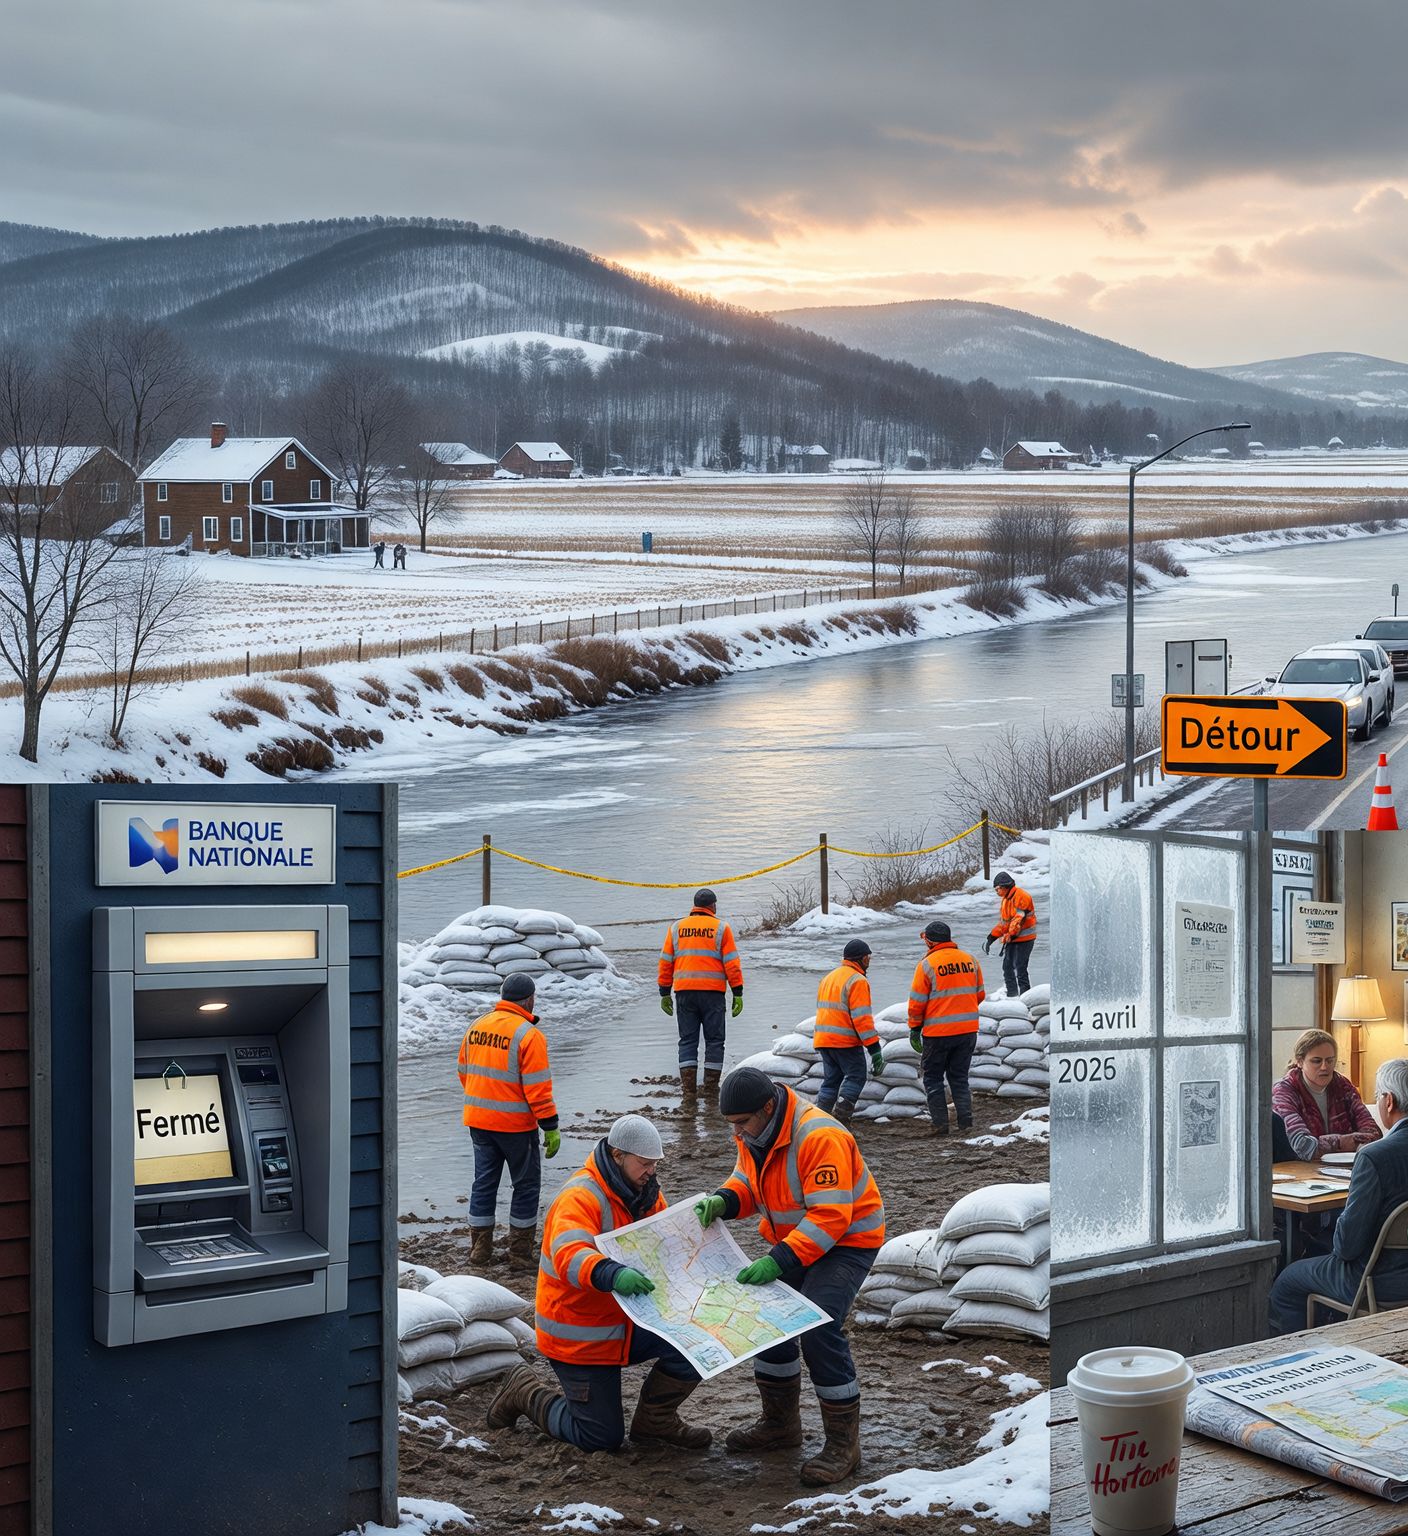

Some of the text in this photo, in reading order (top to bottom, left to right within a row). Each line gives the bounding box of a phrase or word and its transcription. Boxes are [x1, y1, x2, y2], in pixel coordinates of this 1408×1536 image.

[1181, 716, 1300, 752] Détour
[188, 820, 283, 844] BANQUE
[188, 847, 313, 867] NATIONALE
[1056, 1004, 1136, 1031] 14 avril
[1058, 1056, 1117, 1084] 2026
[136, 1103, 221, 1140] Fermé
